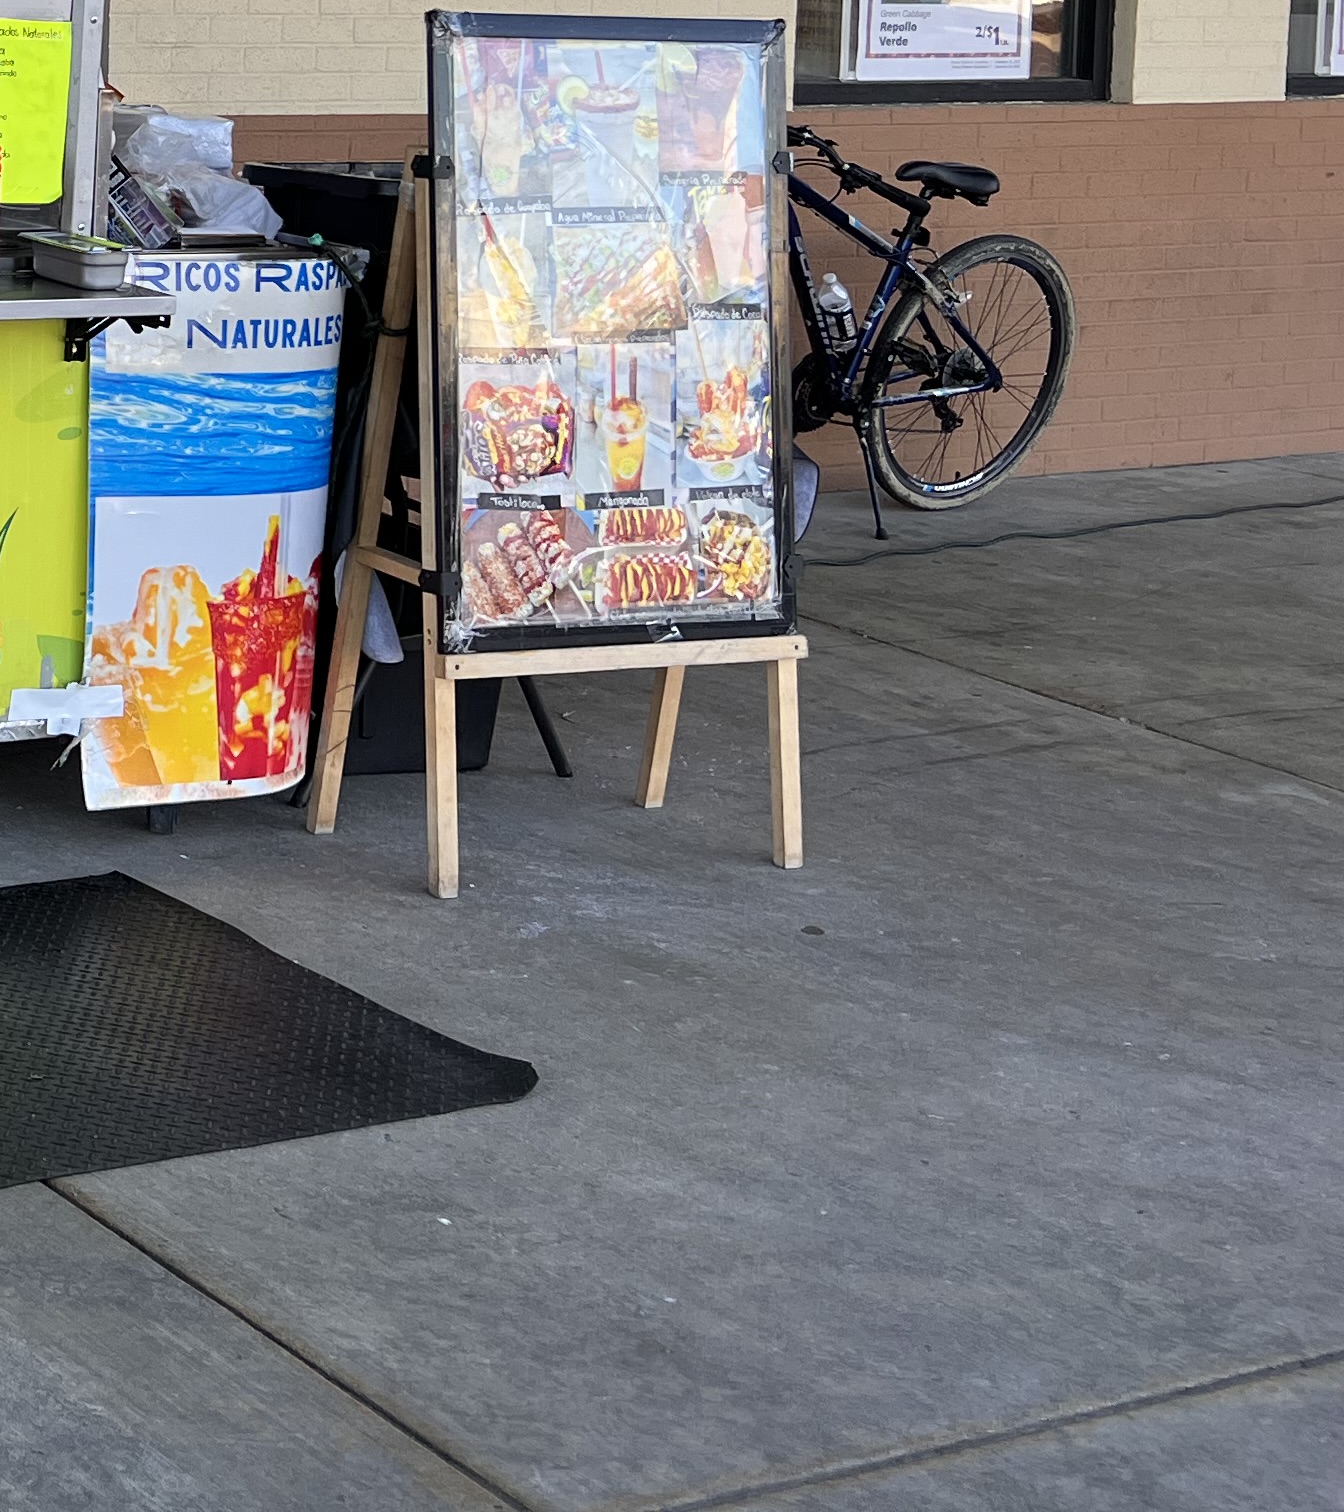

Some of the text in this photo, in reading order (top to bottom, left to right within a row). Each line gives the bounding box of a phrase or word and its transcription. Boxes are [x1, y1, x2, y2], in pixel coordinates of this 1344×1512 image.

[881, 9, 932, 20] Green Cabbage
[880, 22, 917, 35] Repollo
[879, 36, 909, 46] Verde
[558, 211, 579, 224] Agua
[134, 261, 240, 293] RICOS
[187, 316, 342, 349] NATURALES
